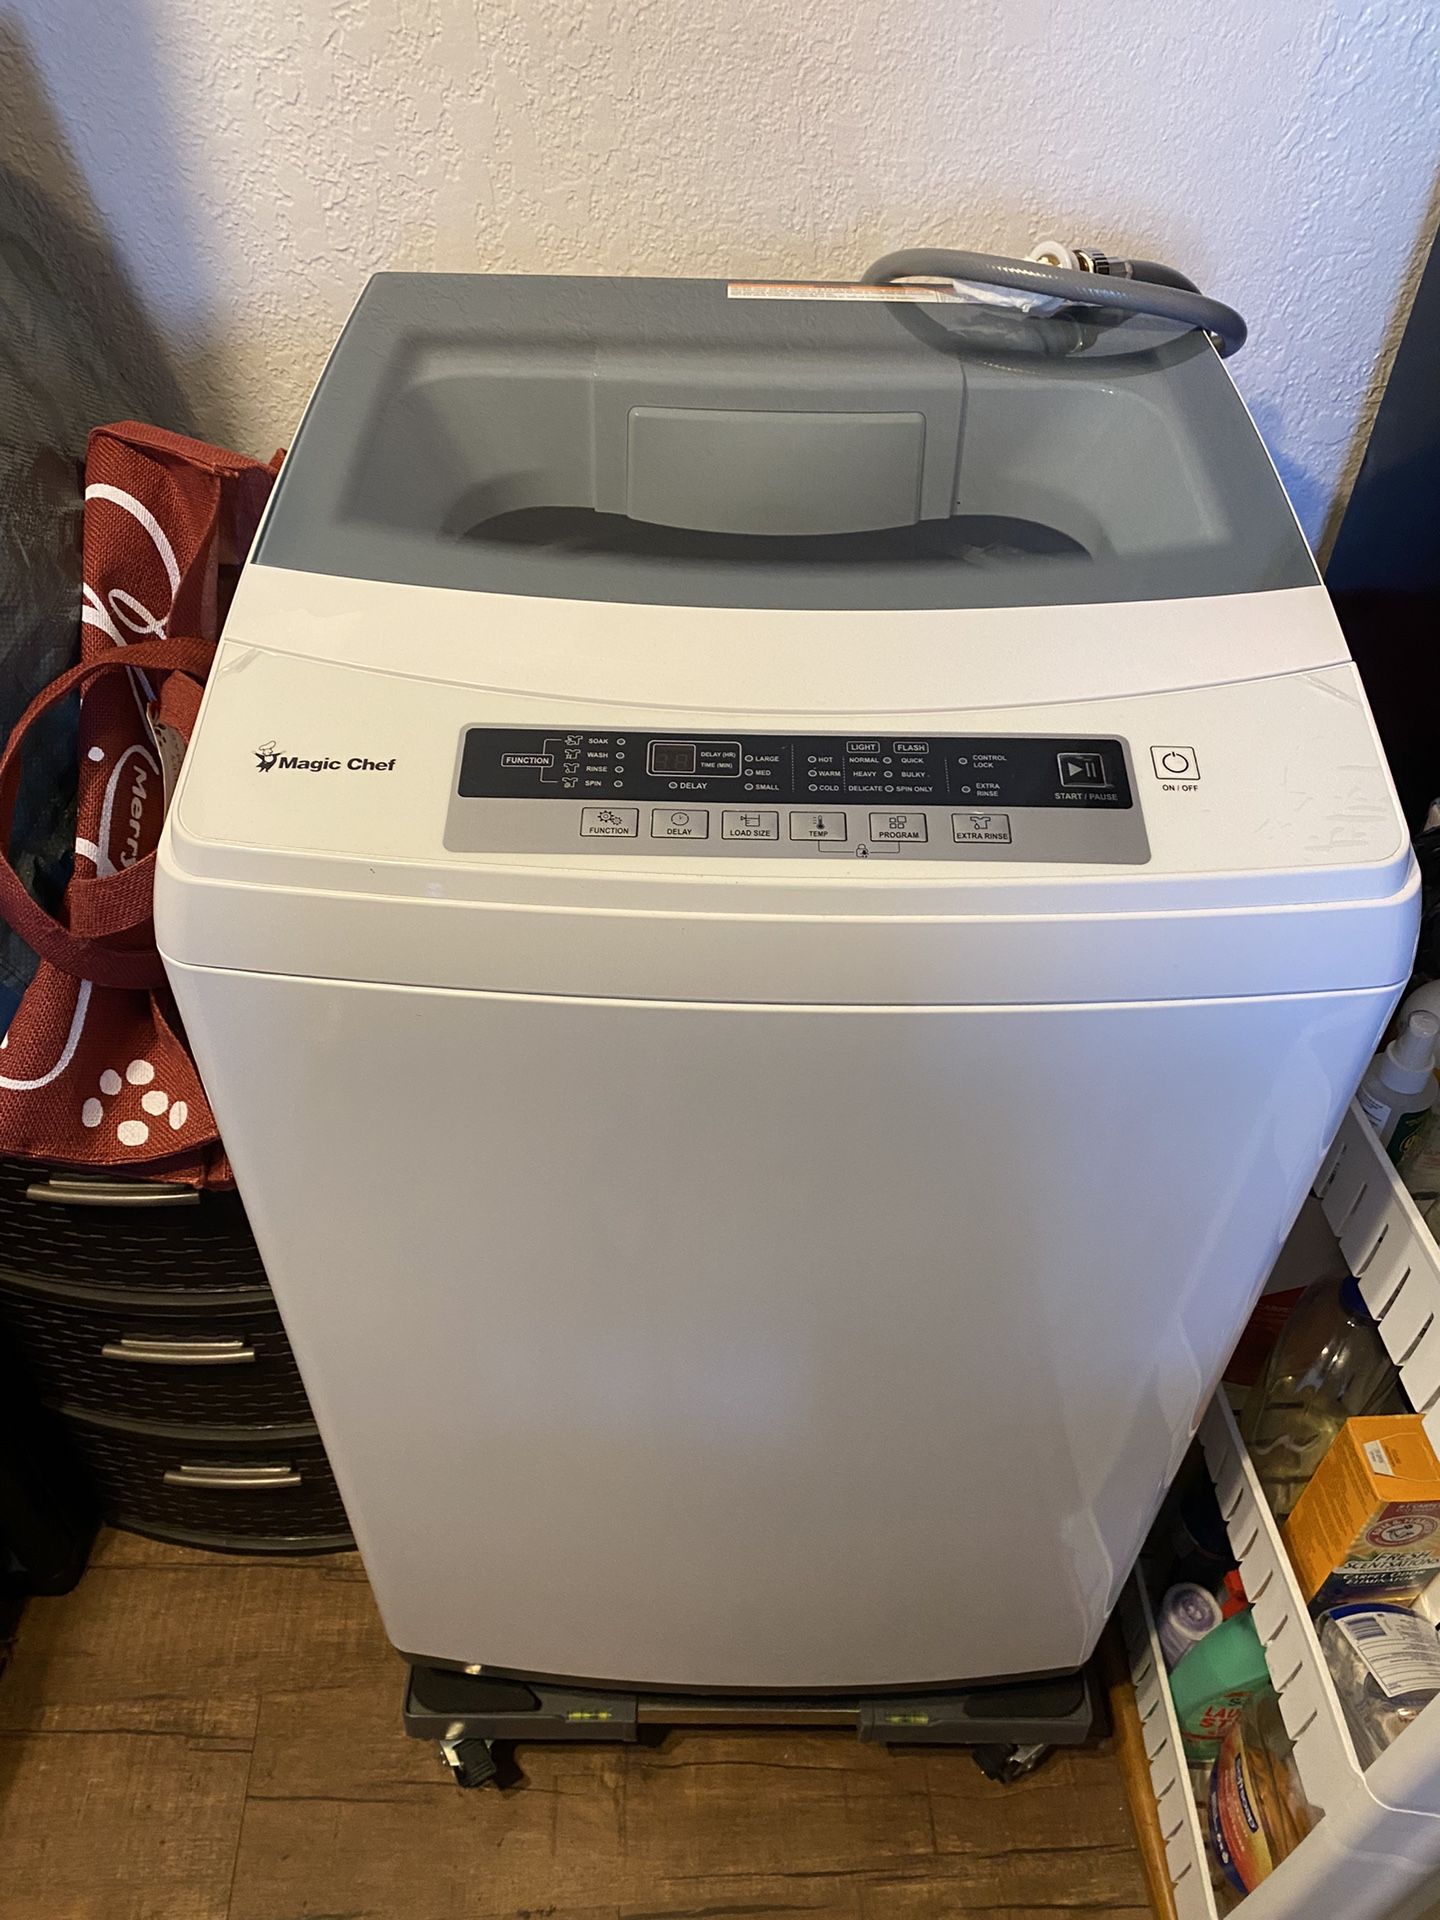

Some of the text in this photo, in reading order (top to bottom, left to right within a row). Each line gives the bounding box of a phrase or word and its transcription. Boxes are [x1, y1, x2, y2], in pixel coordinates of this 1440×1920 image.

[897, 744, 925, 752] FLASH
[506, 757, 549, 765] FUNCTION
[972, 754, 1007, 762] CONTROL
[278, 757, 396, 773] Magic Chef
[680, 782, 708, 790] DELAY
[1162, 784, 1175, 792] ON
[1181, 784, 1198, 792] OFF
[1055, 792, 1082, 800] START
[1089, 793, 1118, 801] PAUSE
[589, 826, 629, 835] FUNCTION
[666, 828, 693, 836] DELAY
[730, 829, 752, 837] LOAD
[808, 830, 829, 838] TEMP
[878, 831, 920, 839] PROGRAM
[956, 832, 1009, 841] EXTRA RINSE
[1376, 1551, 1431, 1561] FRESH
[1204, 1706, 1241, 1718] LAU
